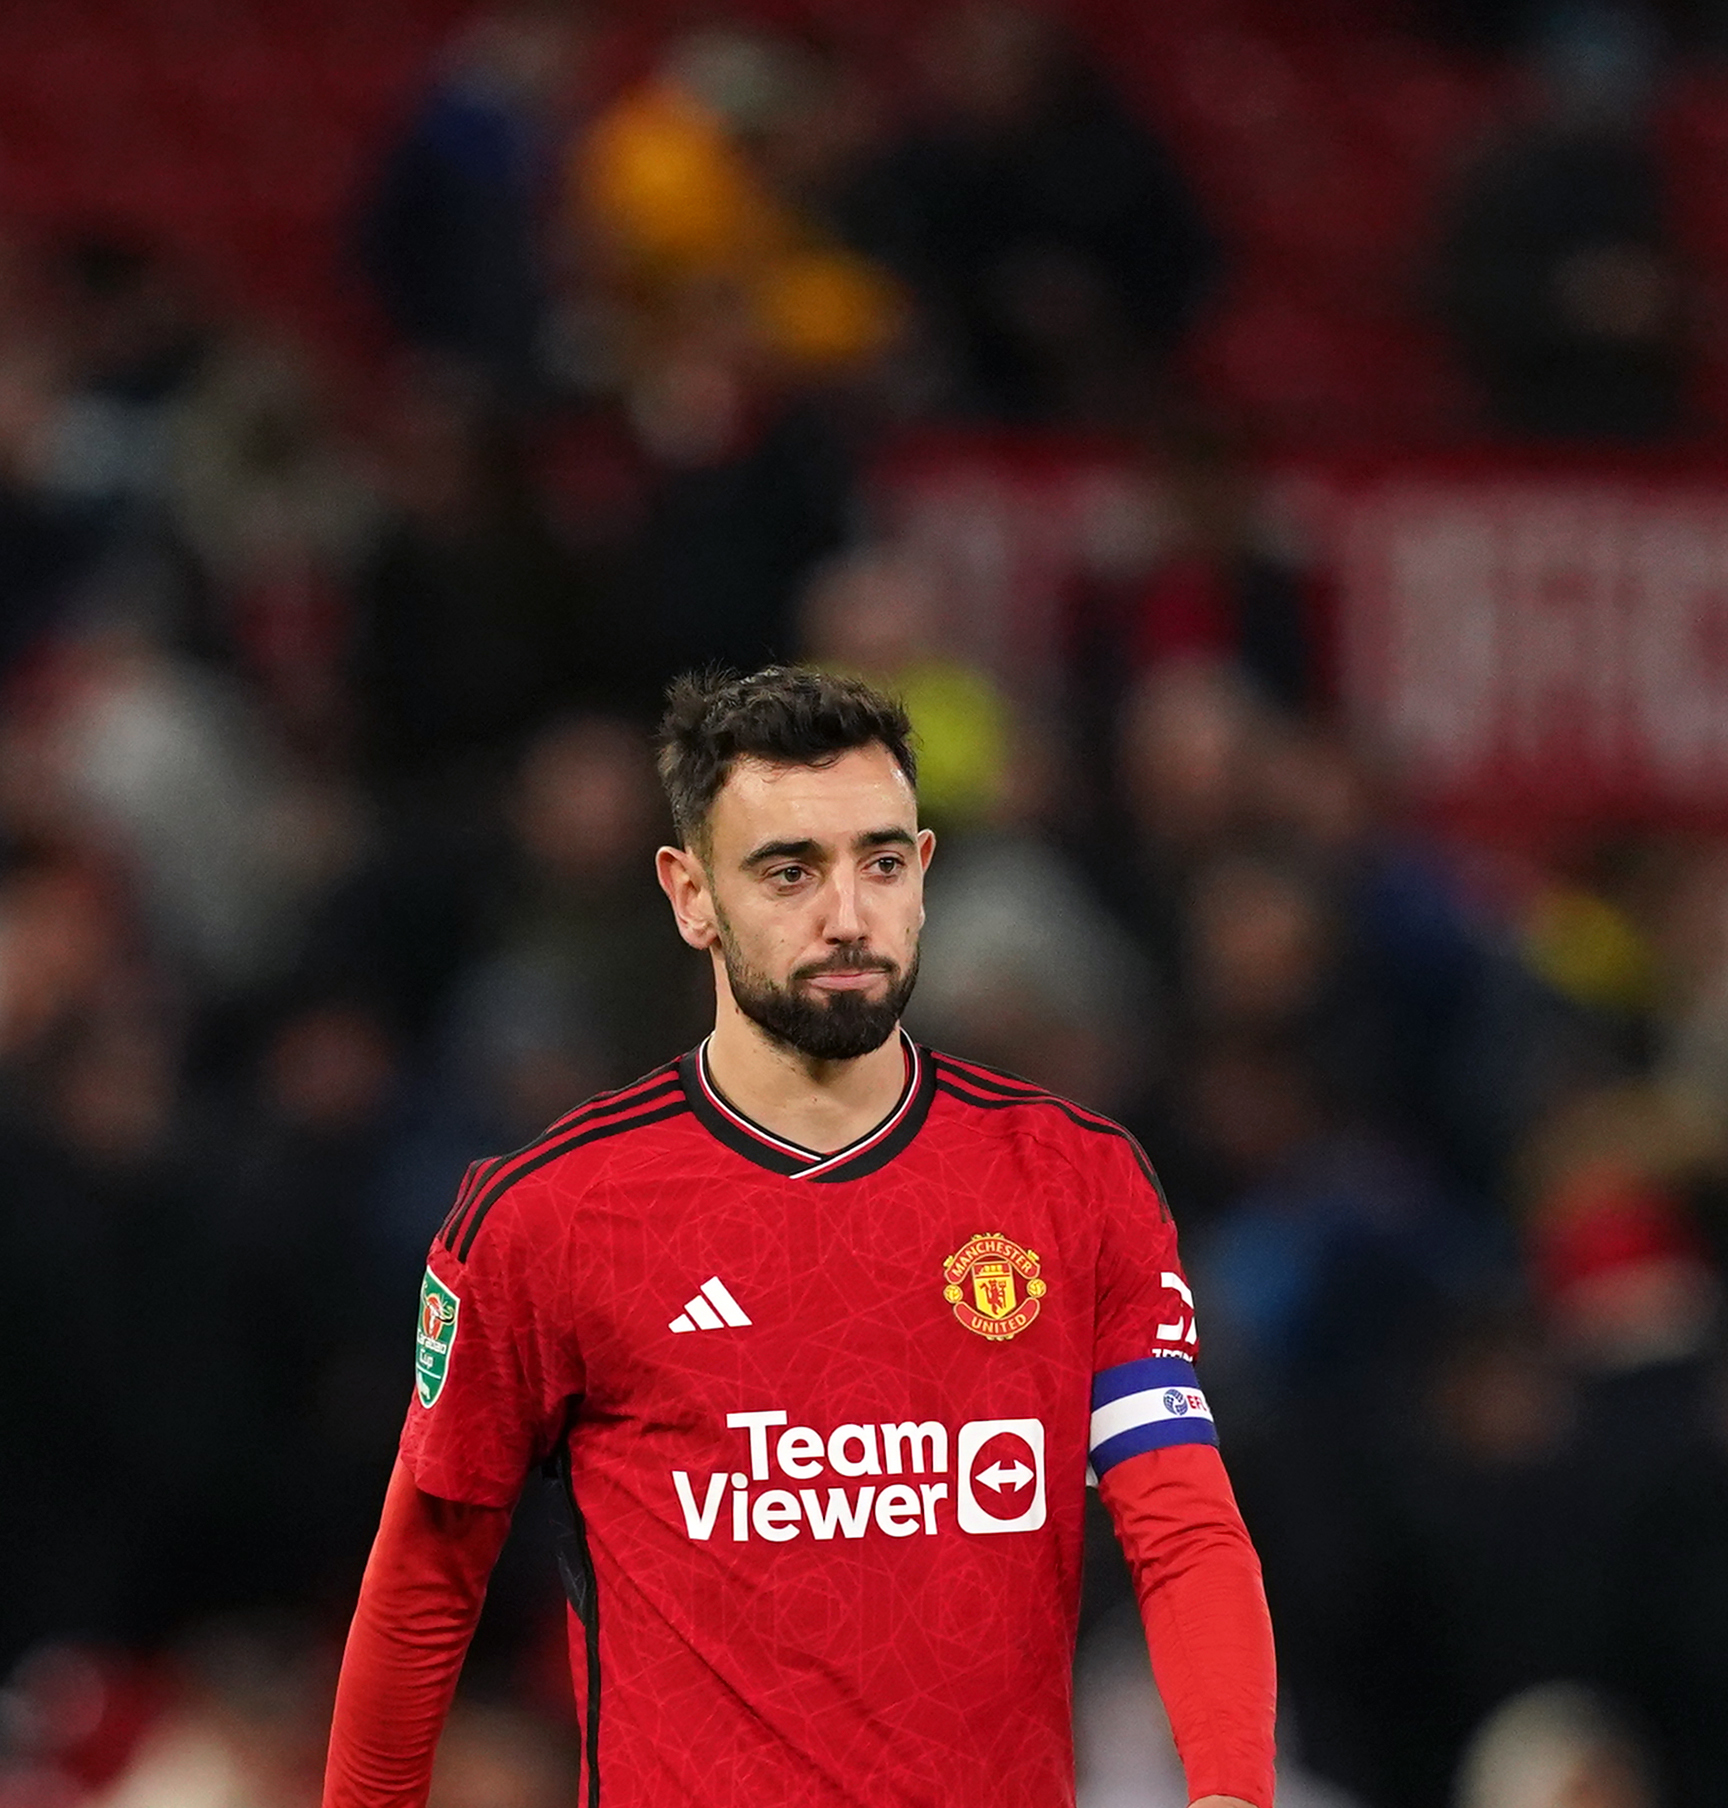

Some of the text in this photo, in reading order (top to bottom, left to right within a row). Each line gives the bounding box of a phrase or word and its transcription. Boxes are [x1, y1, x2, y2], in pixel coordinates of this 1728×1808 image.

[951, 1240, 1033, 1278] MANCHESTER
[971, 1313, 1027, 1334] UNITED
[725, 1409, 949, 1482] Team
[671, 1470, 949, 1543] Viewer
